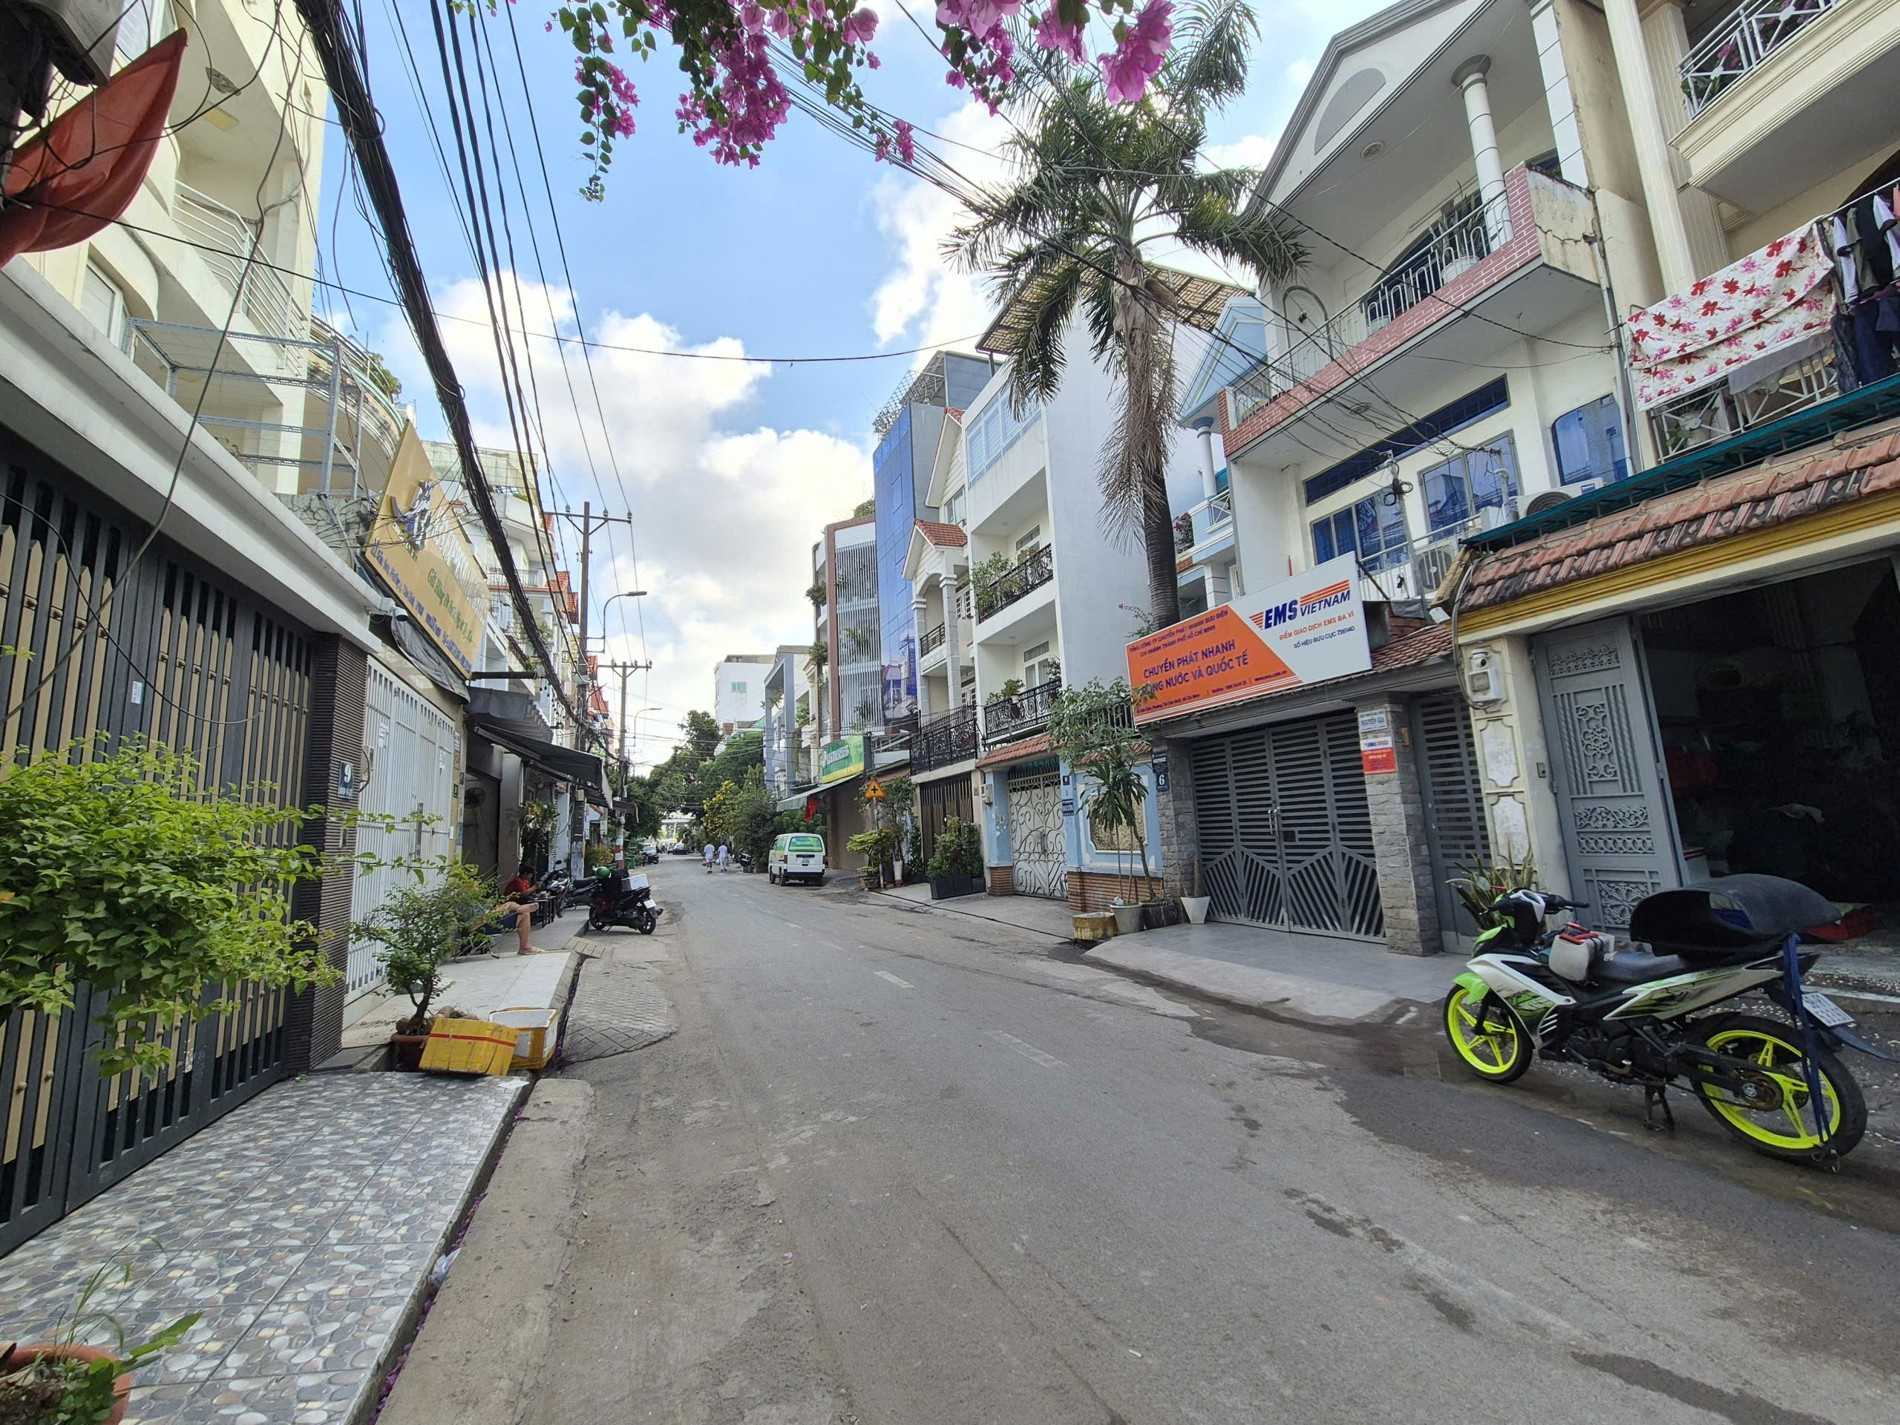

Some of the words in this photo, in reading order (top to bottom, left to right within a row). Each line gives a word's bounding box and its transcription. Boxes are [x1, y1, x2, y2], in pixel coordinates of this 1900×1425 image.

[1264, 599, 1298, 629] EMS
[1300, 590, 1350, 616] VIETNAM
[1293, 627, 1306, 636] GIAO
[1308, 622, 1322, 632] DỊCH
[1323, 618, 1336, 626] EMS
[1177, 652, 1198, 668] PHÁT
[1202, 640, 1235, 660] NHANH
[1192, 666, 1204, 680] VÀ
[1206, 656, 1234, 676] QUỐC
[1237, 650, 1248, 666] TẾ
[344, 764, 352, 783] 9
[1158, 774, 1165, 786] 6
